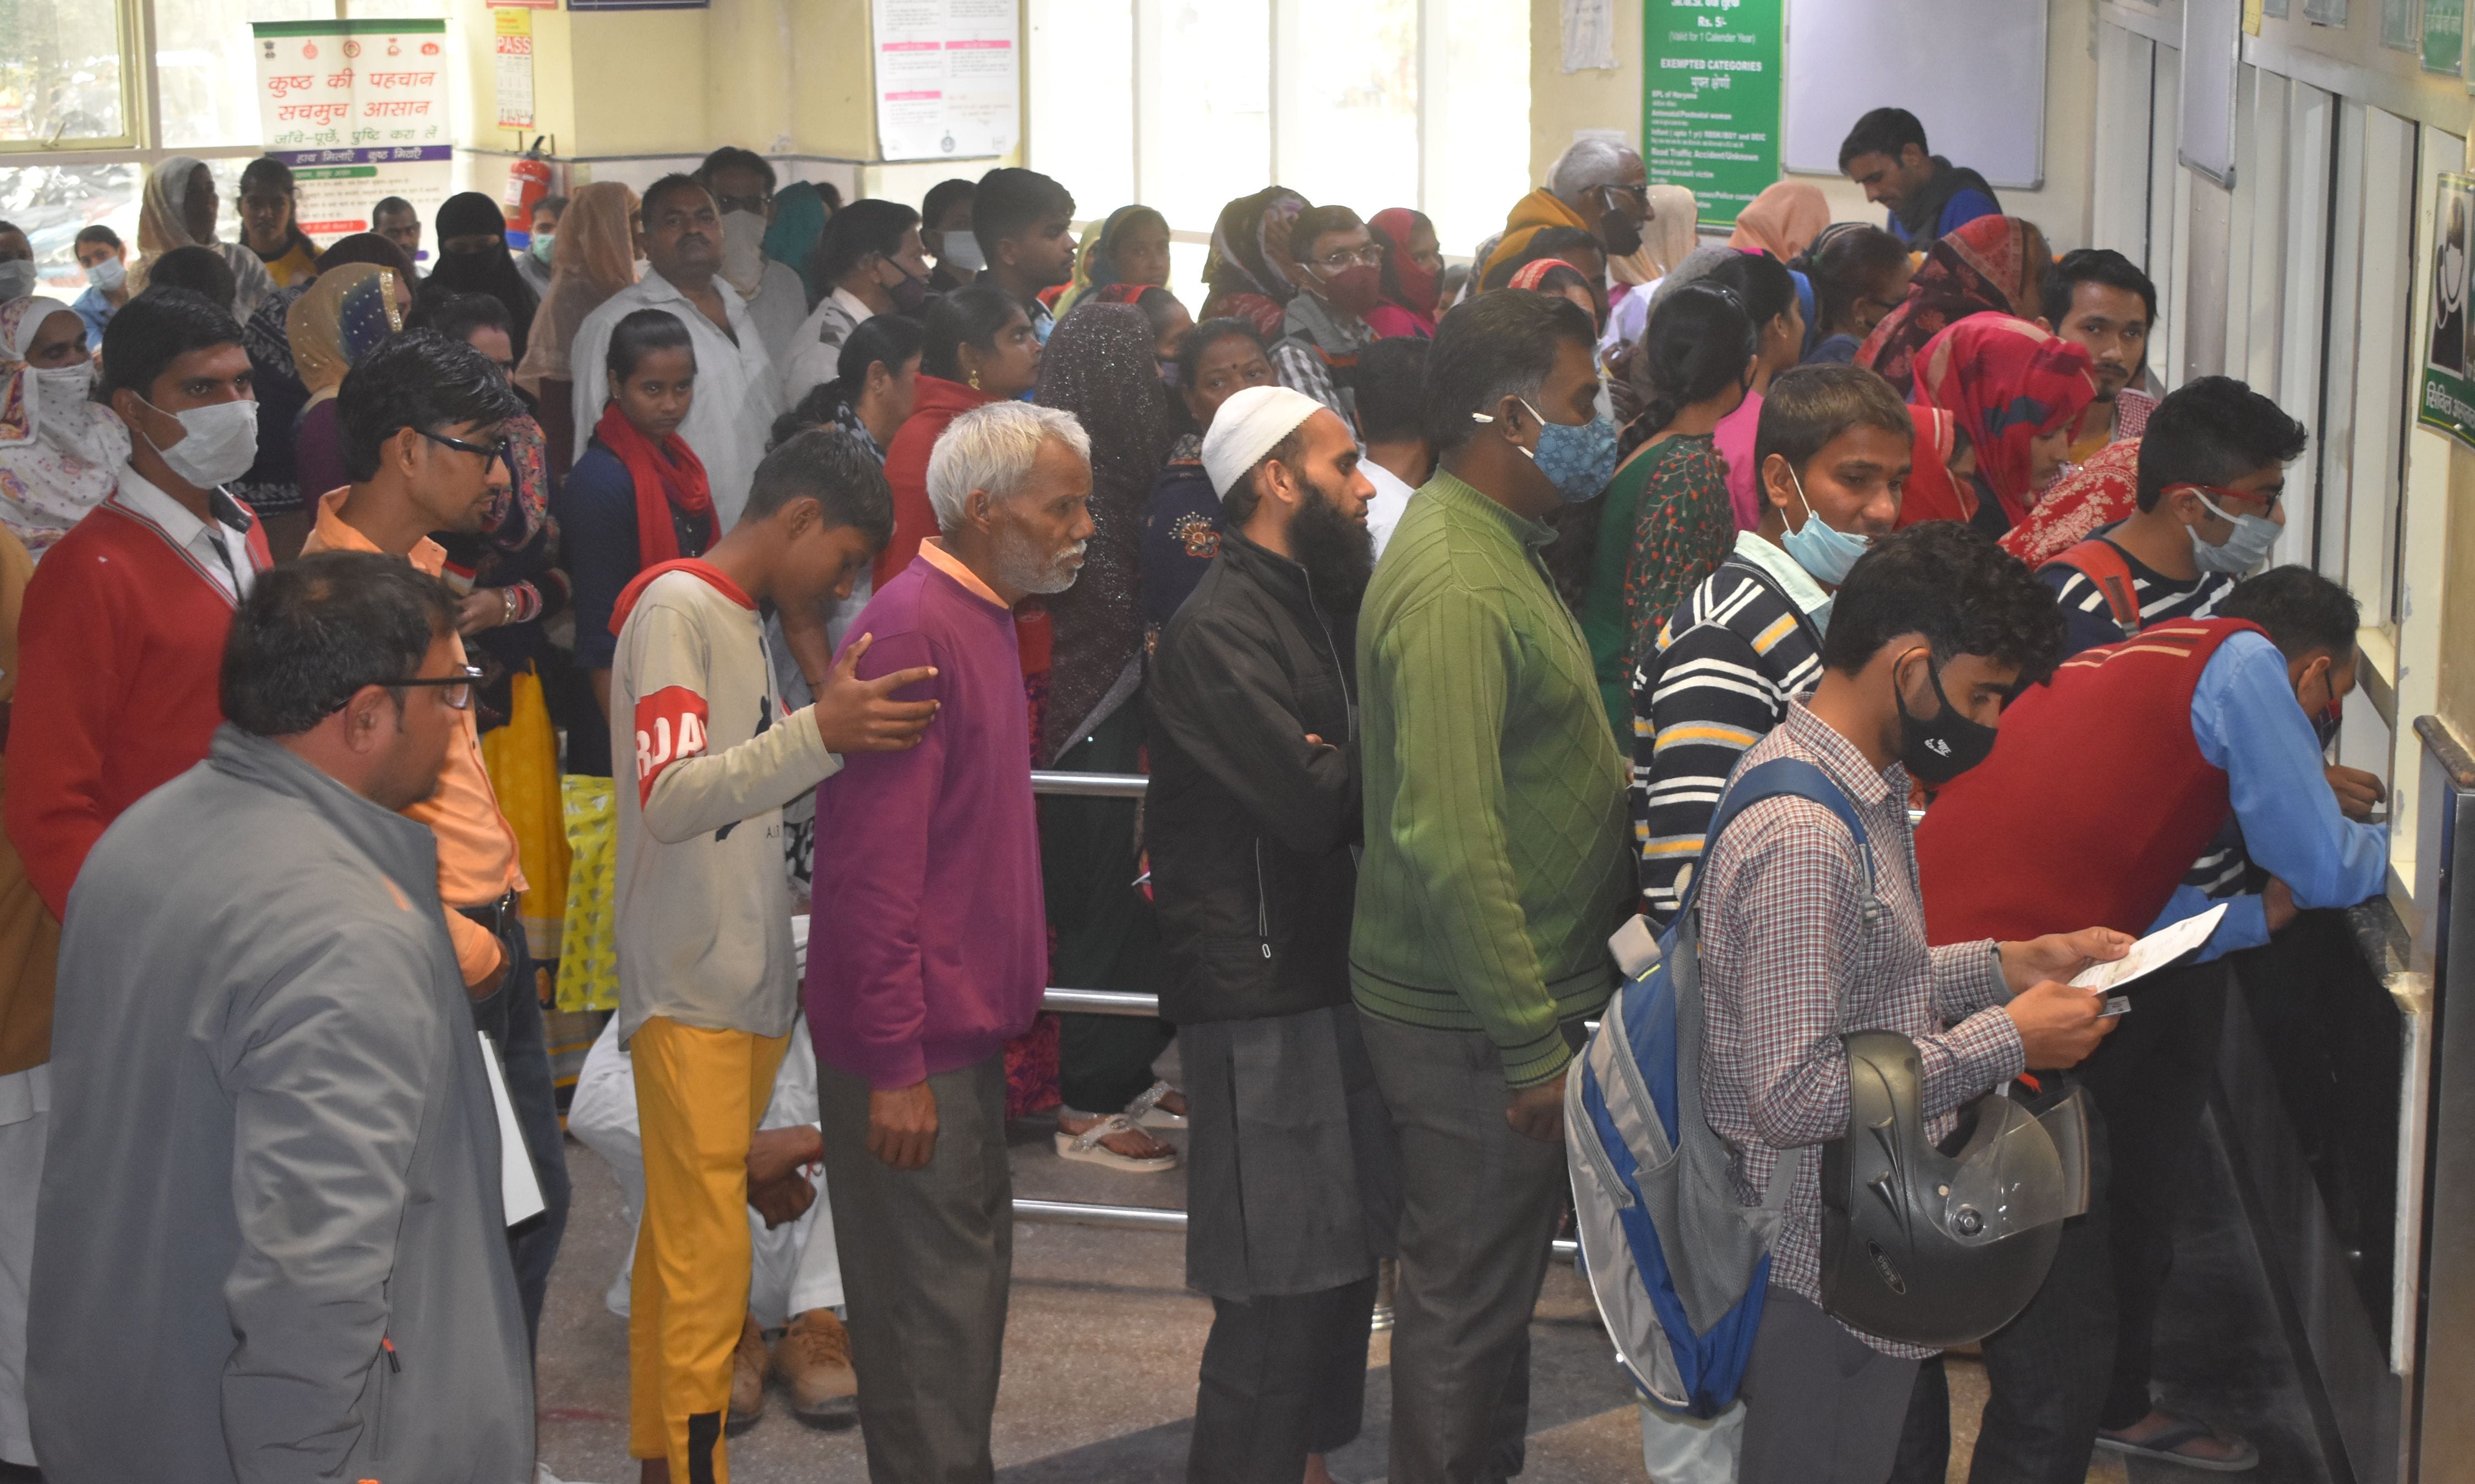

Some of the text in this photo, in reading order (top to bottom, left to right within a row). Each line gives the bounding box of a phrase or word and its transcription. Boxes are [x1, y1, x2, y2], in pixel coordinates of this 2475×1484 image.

[1698, 15, 1713, 27] Rs.
[497, 36, 531, 53] PASS
[1689, 31, 1698, 41] for
[1737, 32, 1756, 45] Year)
[1660, 58, 1762, 71] EXEMPTED CATEGORIES
[269, 67, 437, 98] कुष्ठ की पहचान
[278, 101, 432, 126] सचमुच आसान
[390, 129, 416, 140] करा
